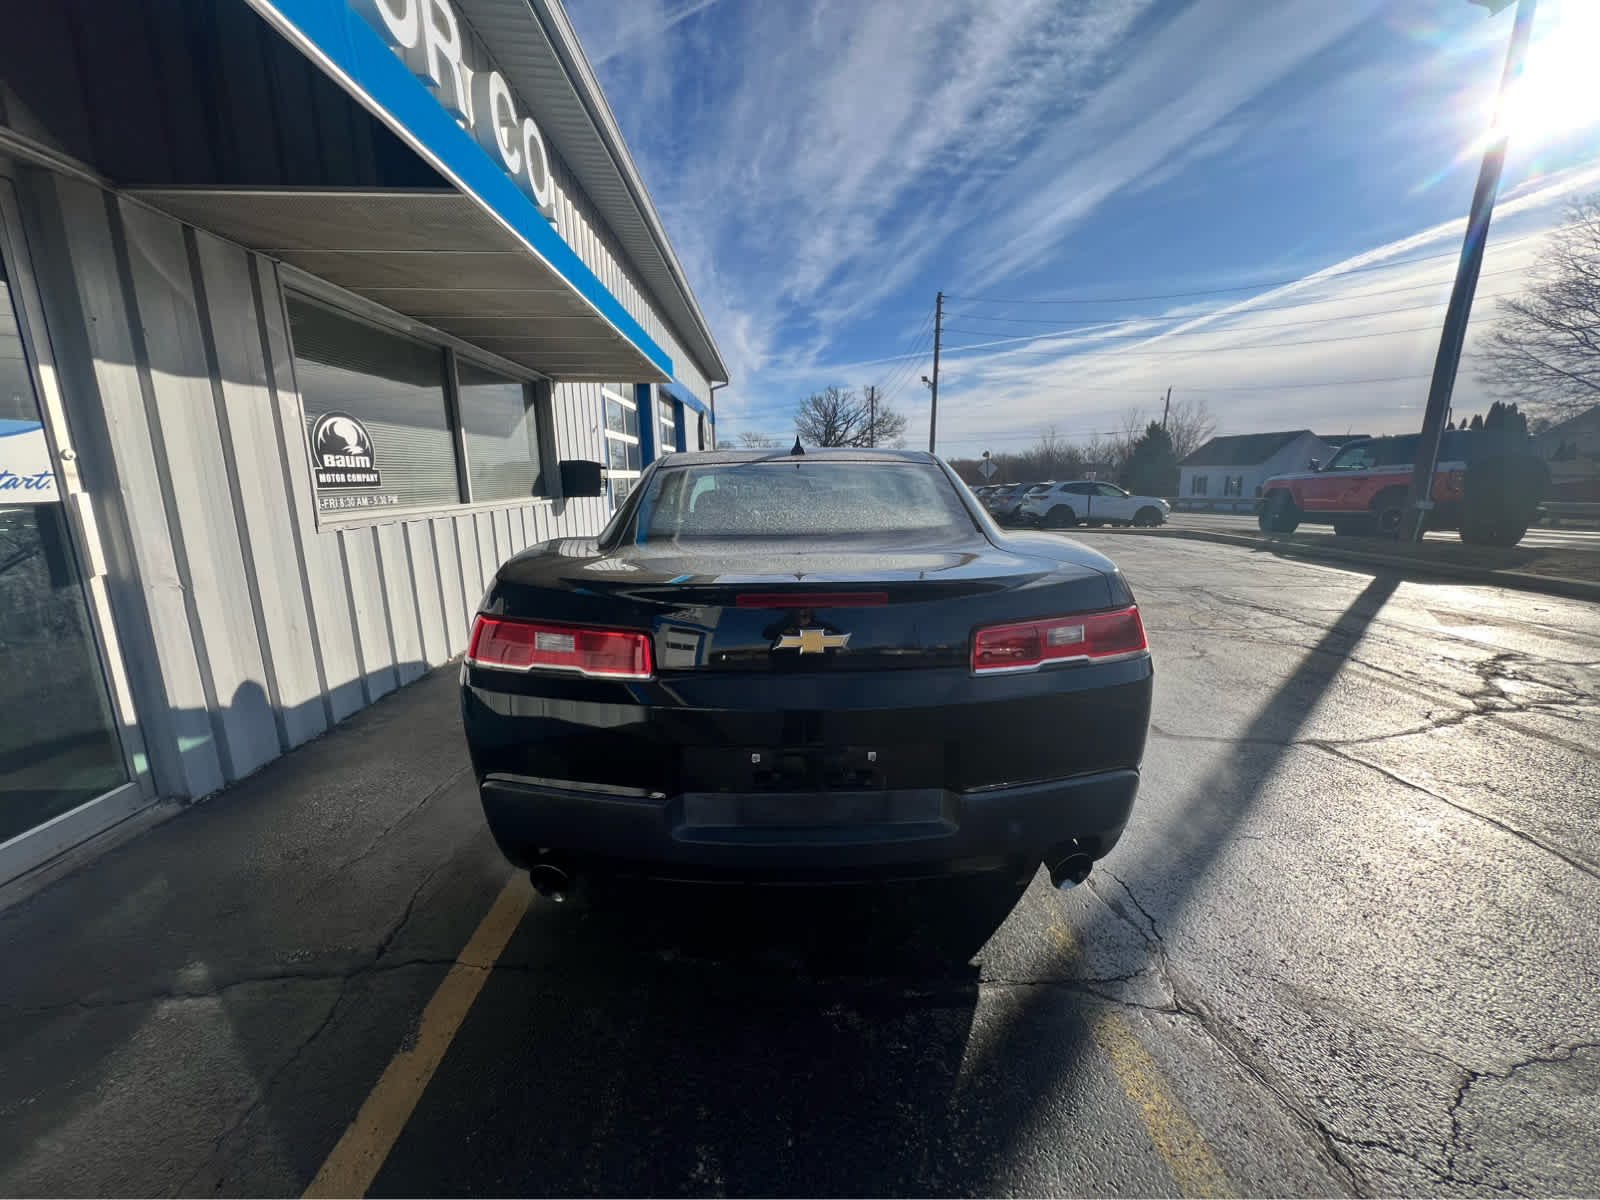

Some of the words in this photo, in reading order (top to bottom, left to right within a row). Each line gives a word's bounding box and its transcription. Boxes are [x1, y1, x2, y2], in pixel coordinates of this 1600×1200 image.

[323, 454, 371, 468] Baum
[319, 473, 346, 483] MOTOR
[346, 473, 378, 482] COMPANY
[357, 496, 369, 506] AM
